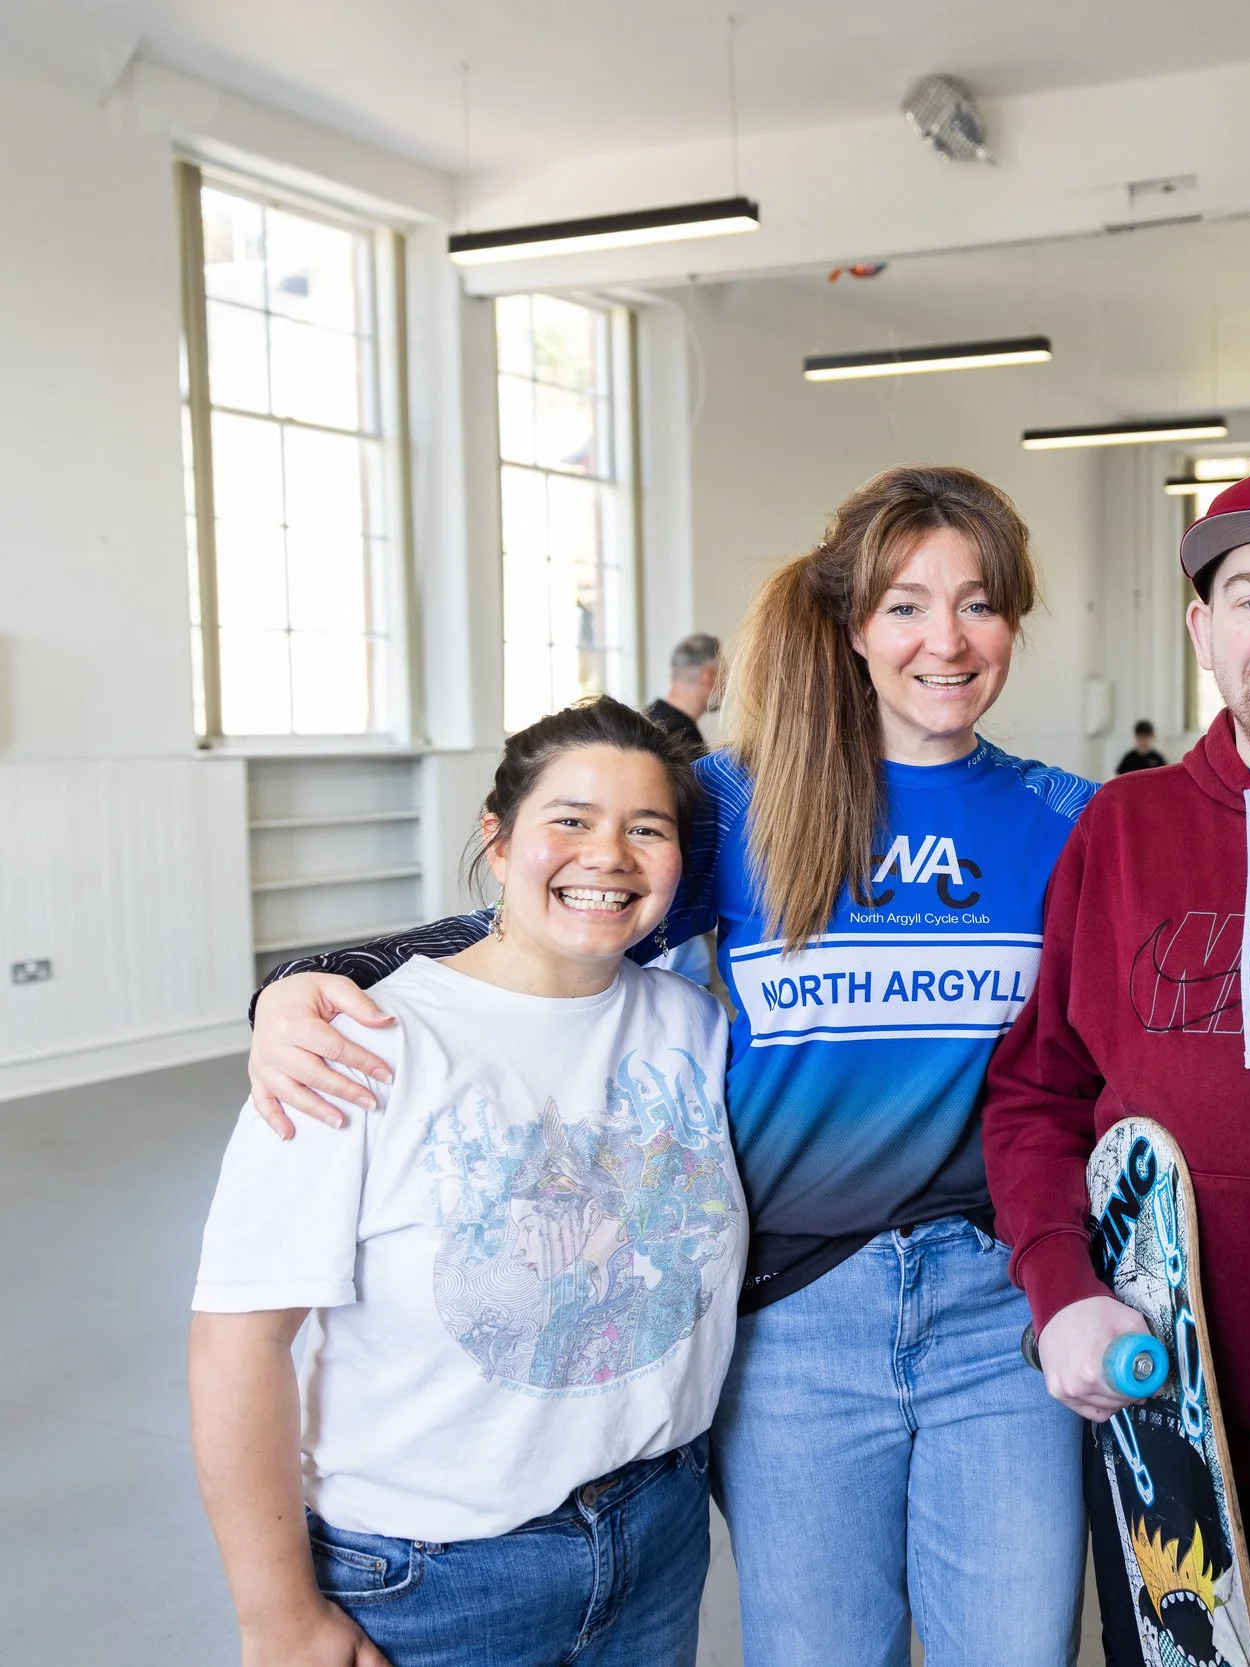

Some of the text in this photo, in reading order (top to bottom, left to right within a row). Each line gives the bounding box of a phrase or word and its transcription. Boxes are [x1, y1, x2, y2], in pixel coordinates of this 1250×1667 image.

[850, 912, 991, 926] North Argyll Cycle Club
[761, 969, 1026, 1012] NORTH ARGYLL
